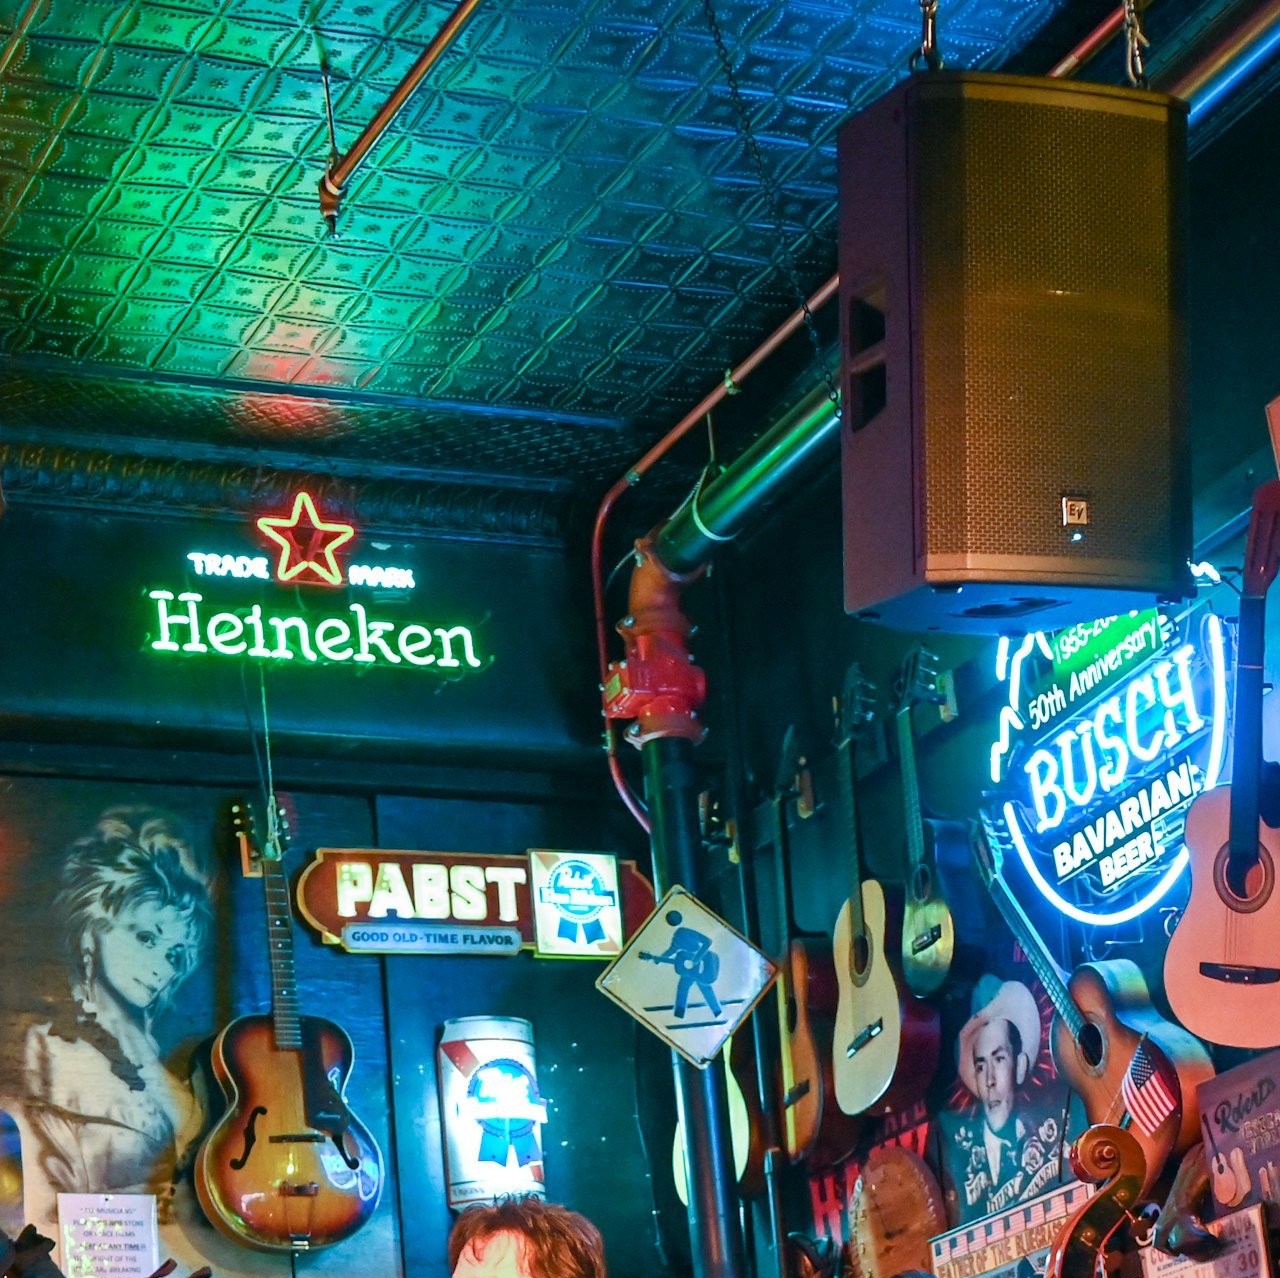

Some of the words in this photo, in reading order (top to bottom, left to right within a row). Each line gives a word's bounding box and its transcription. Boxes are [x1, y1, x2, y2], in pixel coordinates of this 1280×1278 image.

[187, 552, 270, 580] TRADE
[348, 564, 416, 589] MARK
[149, 590, 481, 668] Heineken
[1029, 683, 1066, 730] 50th
[1070, 617, 1156, 702] Anniversary
[1024, 643, 1204, 834] BUSCH
[1053, 764, 1195, 878] BAVARIAN
[1099, 830, 1158, 887] BEER
[336, 861, 527, 922] PABST
[352, 930, 389, 944] GOOD
[462, 933, 514, 946] FLAVOR
[992, 1238, 1014, 1267] THE
[1237, 1249, 1259, 1273] 30
